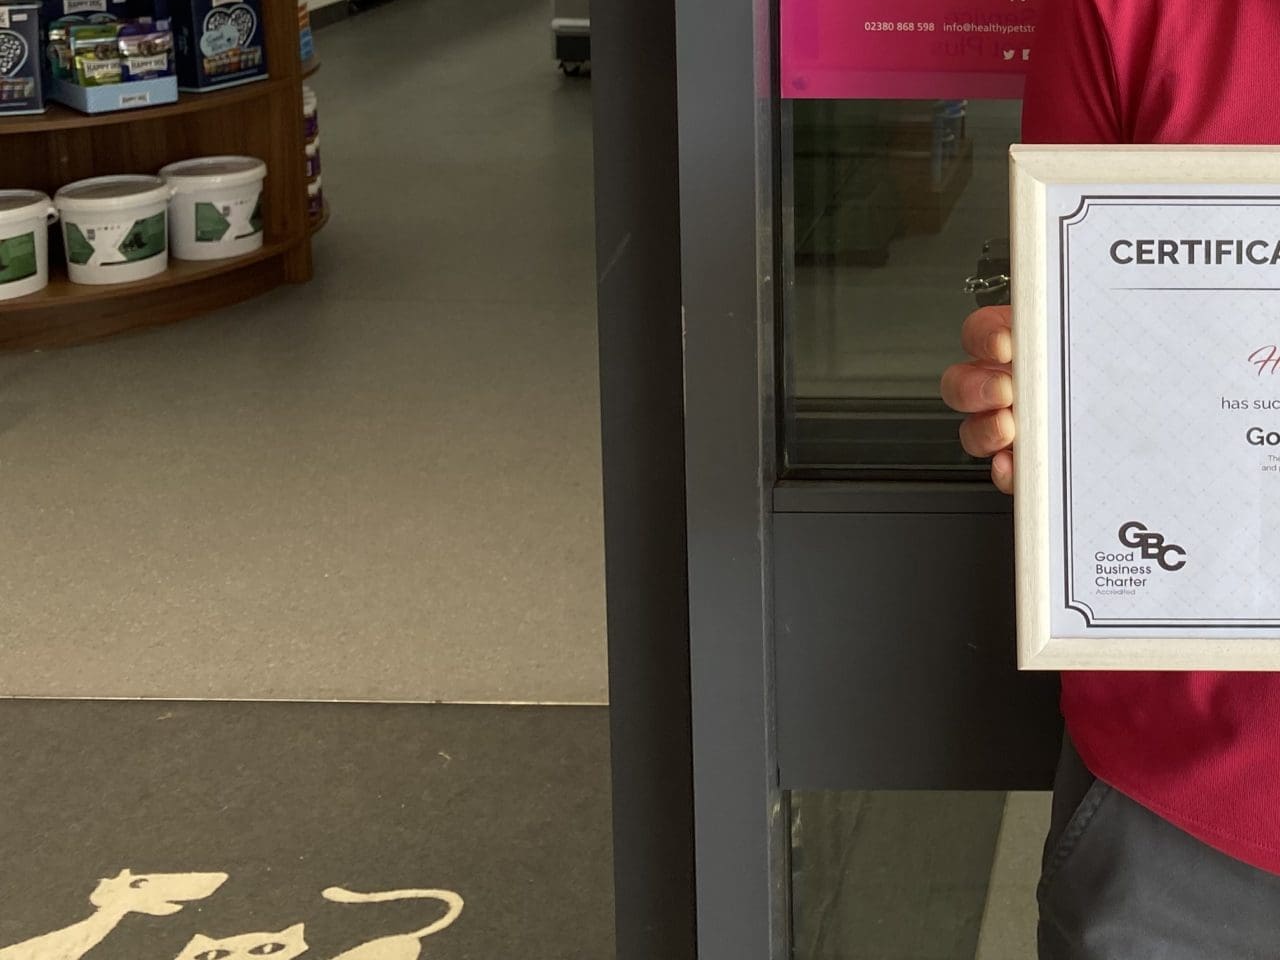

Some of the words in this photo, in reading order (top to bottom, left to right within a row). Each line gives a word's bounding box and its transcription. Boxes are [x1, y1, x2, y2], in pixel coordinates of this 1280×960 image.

[864, 21, 895, 32] 02380
[896, 22, 915, 32] 868
[917, 22, 935, 32] 598
[1221, 396, 1249, 410] has
[1261, 463, 1277, 472] and
[1118, 521, 1187, 572] GBC
[1094, 551, 1135, 563] Good
[1096, 564, 1152, 575] Business
[1094, 576, 1148, 588] Charter
[1095, 588, 1136, 596] Accredited
